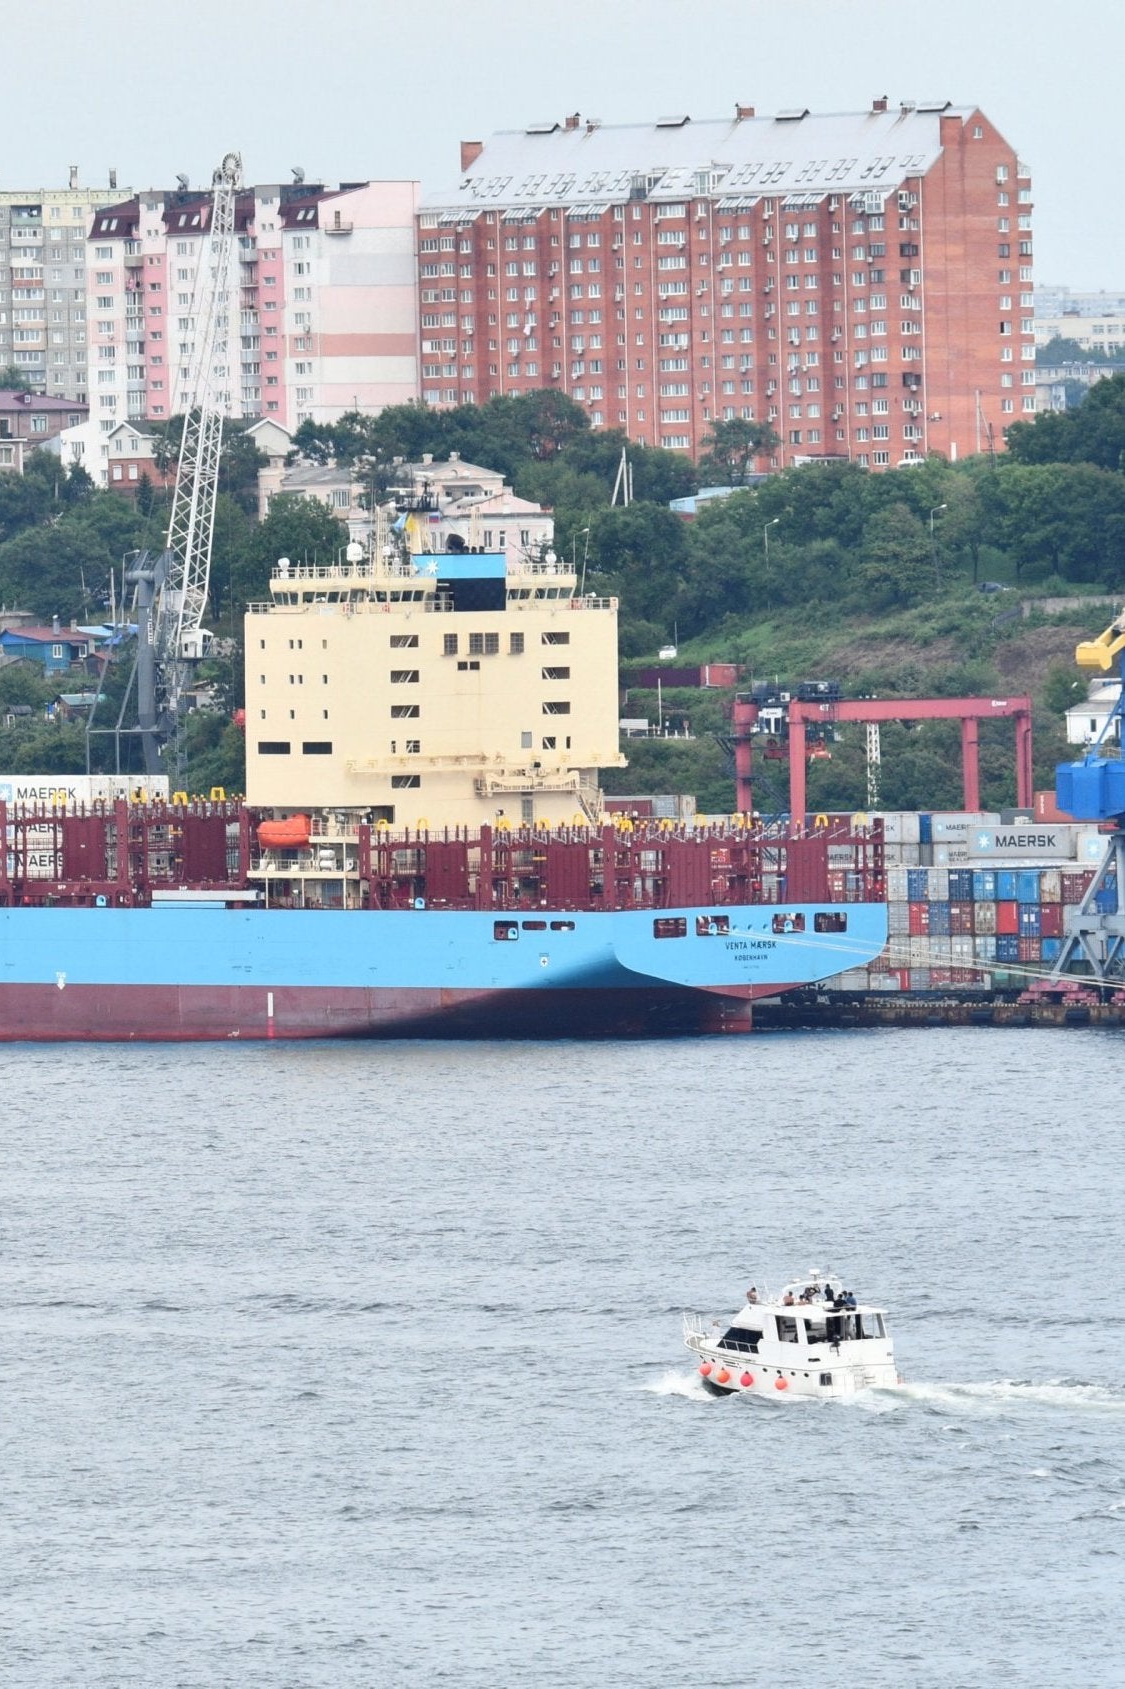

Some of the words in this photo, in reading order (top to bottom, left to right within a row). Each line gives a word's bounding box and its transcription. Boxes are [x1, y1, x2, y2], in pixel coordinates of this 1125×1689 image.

[995, 835, 1056, 848] MAERSK
[725, 941, 748, 950] VENTA
[750, 940, 777, 949] MÆRSK
